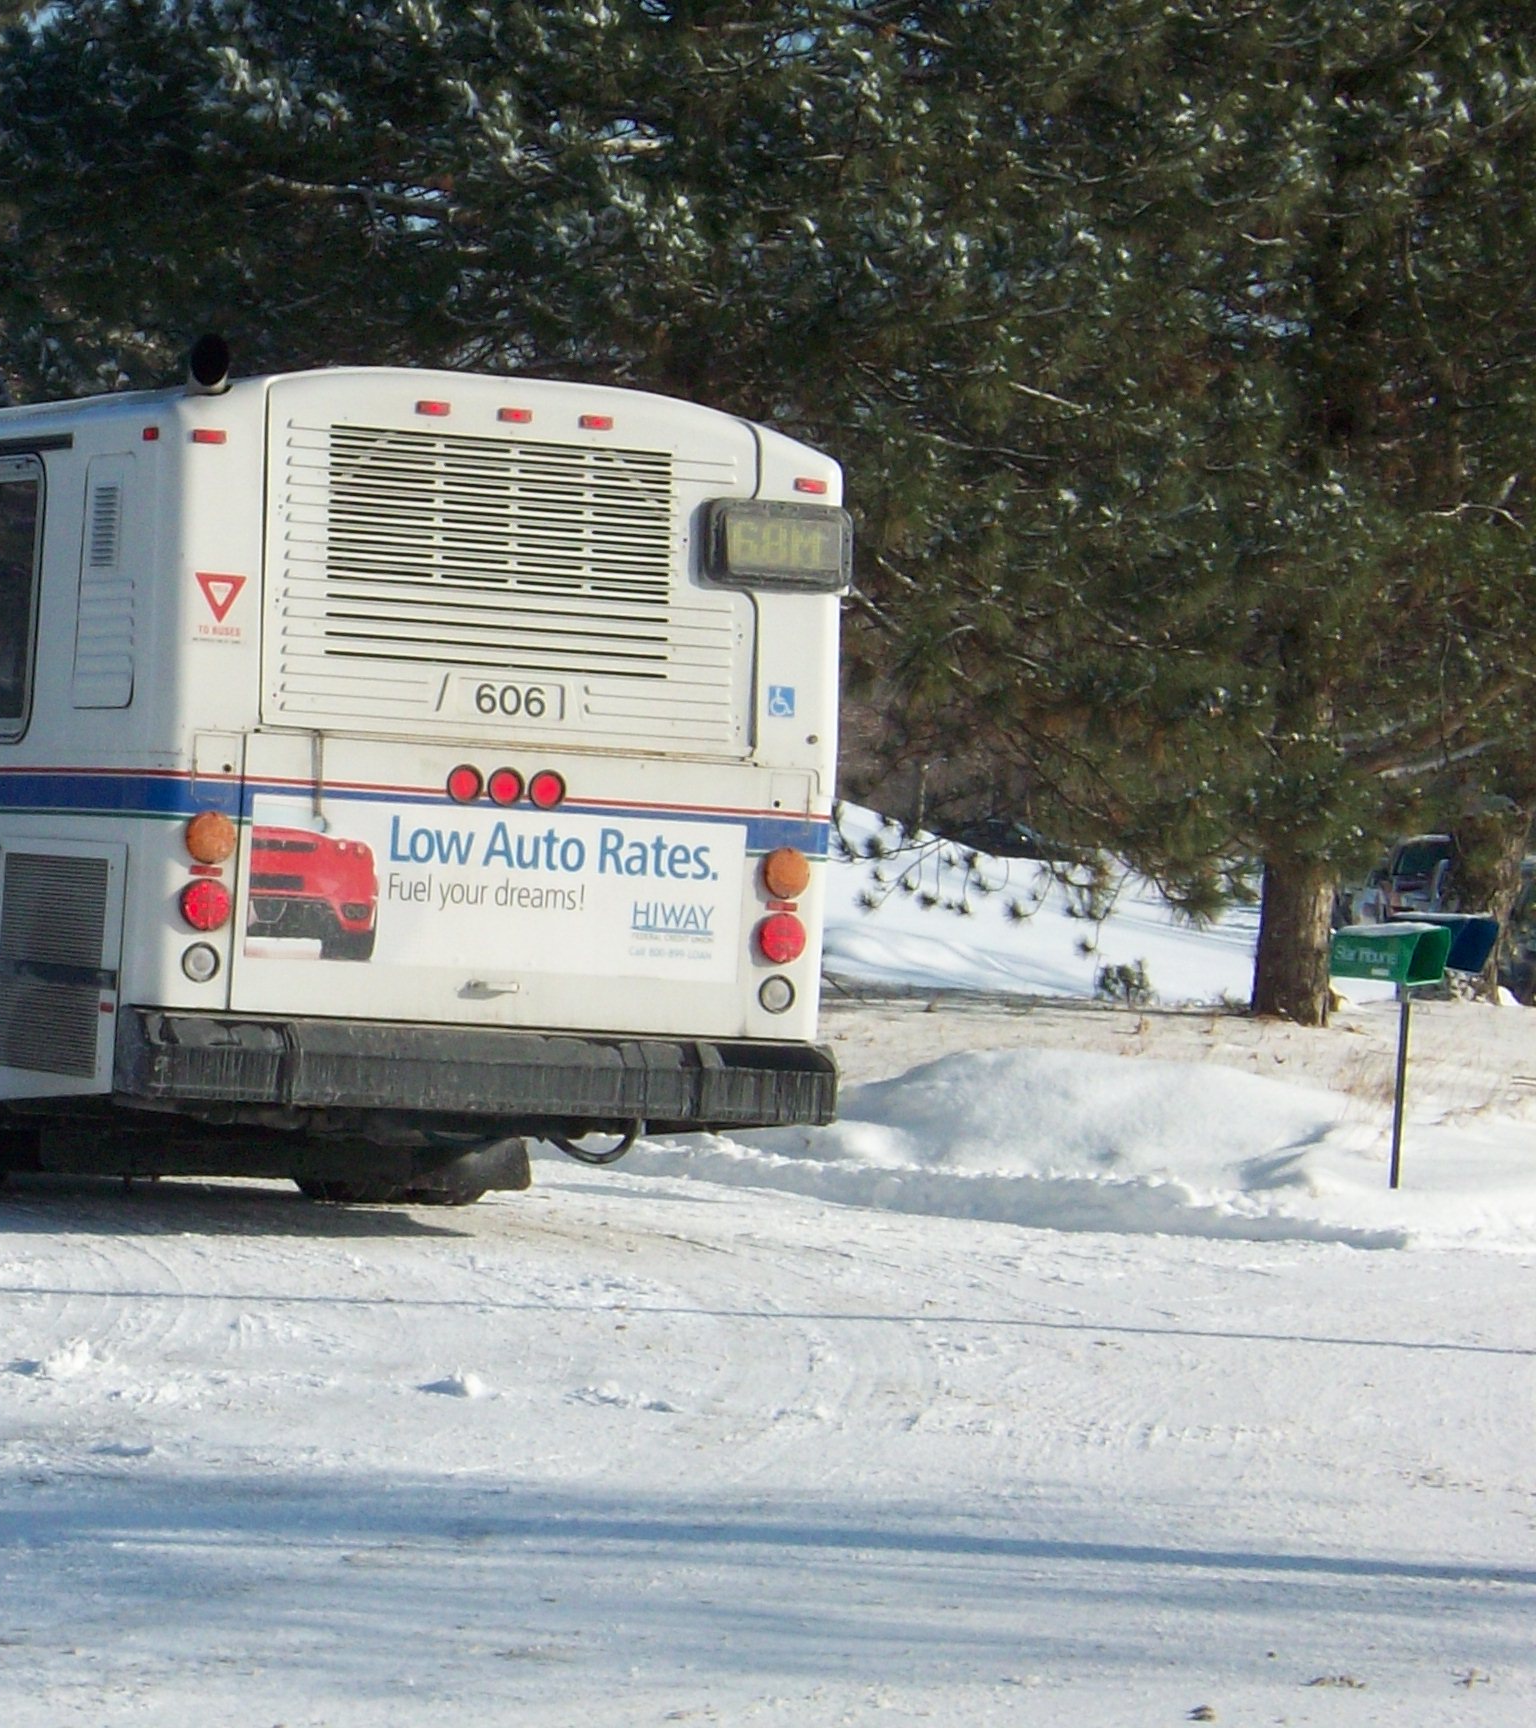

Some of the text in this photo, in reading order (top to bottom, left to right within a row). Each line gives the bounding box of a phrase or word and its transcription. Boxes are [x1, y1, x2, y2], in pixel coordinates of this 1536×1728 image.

[199, 625, 209, 634] TO
[475, 683, 546, 718] 606
[390, 815, 718, 881] Low Auto Rates.
[388, 872, 585, 911] Fuel your dreams!
[632, 901, 715, 929] HIWAY
